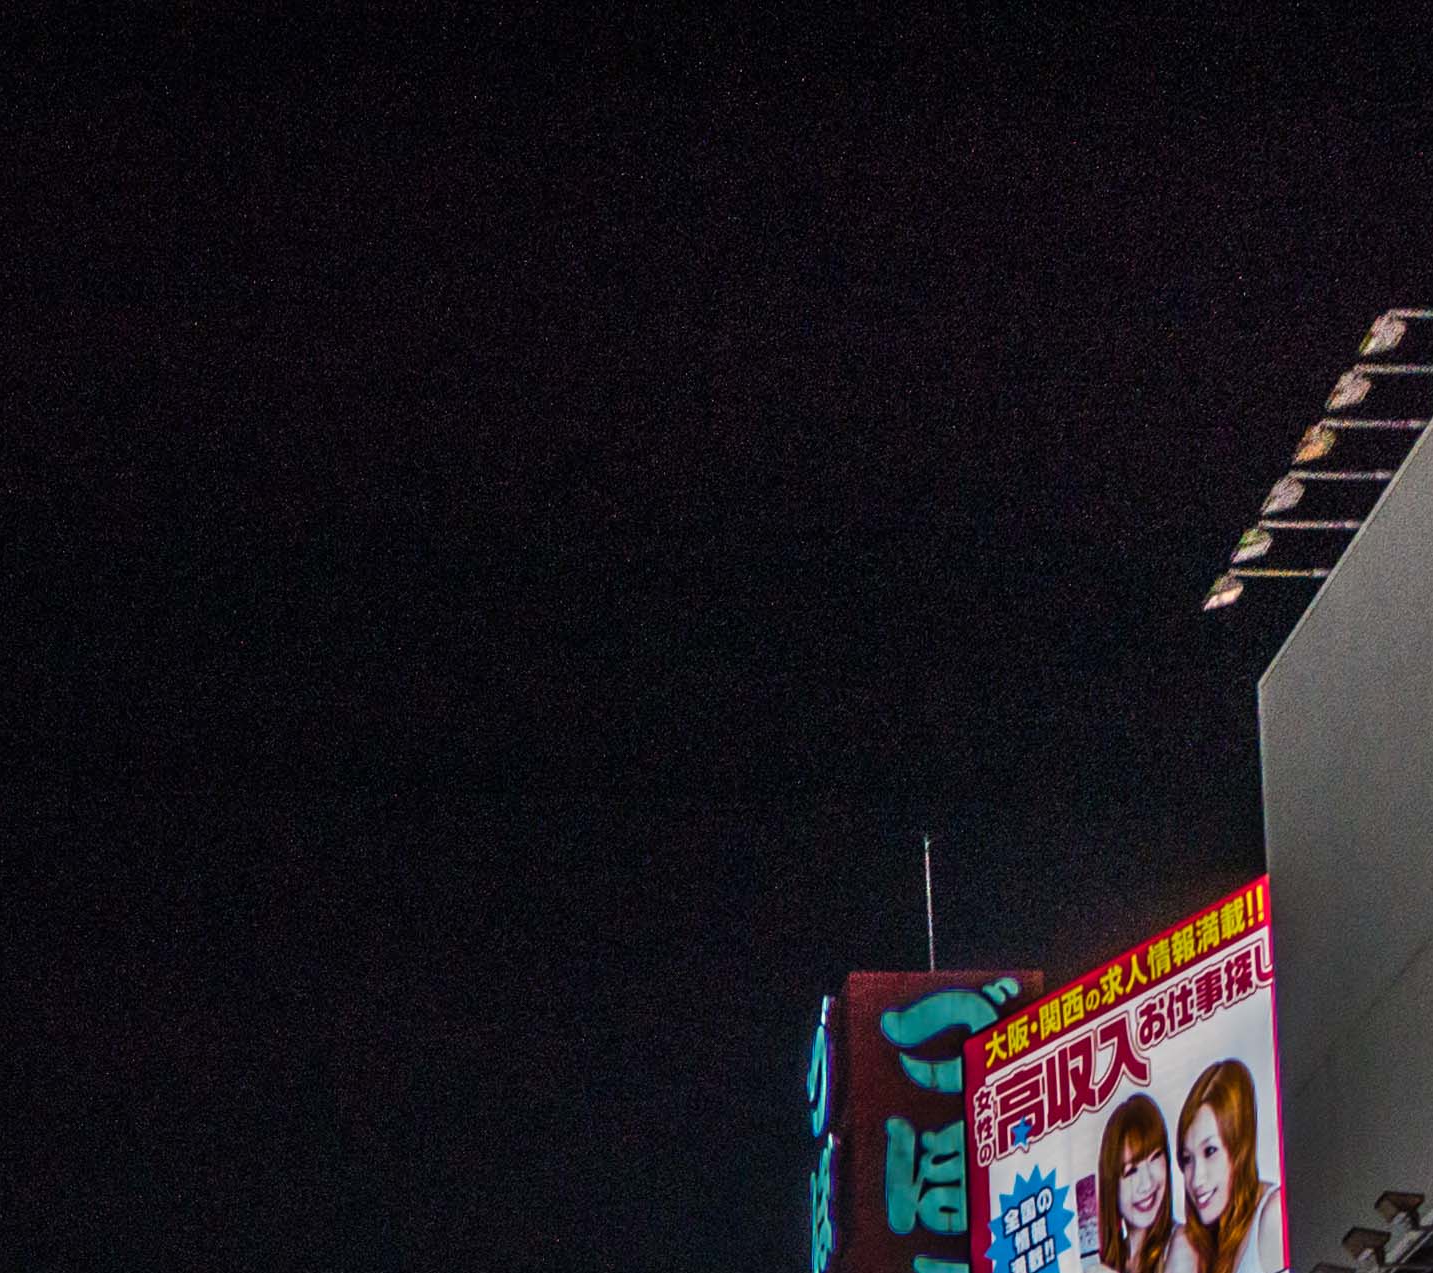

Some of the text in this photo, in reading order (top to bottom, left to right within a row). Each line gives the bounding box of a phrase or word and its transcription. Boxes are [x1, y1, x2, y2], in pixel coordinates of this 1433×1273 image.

[973, 1083, 998, 1168] 女性の
[995, 1024, 1152, 1158] 高収入
